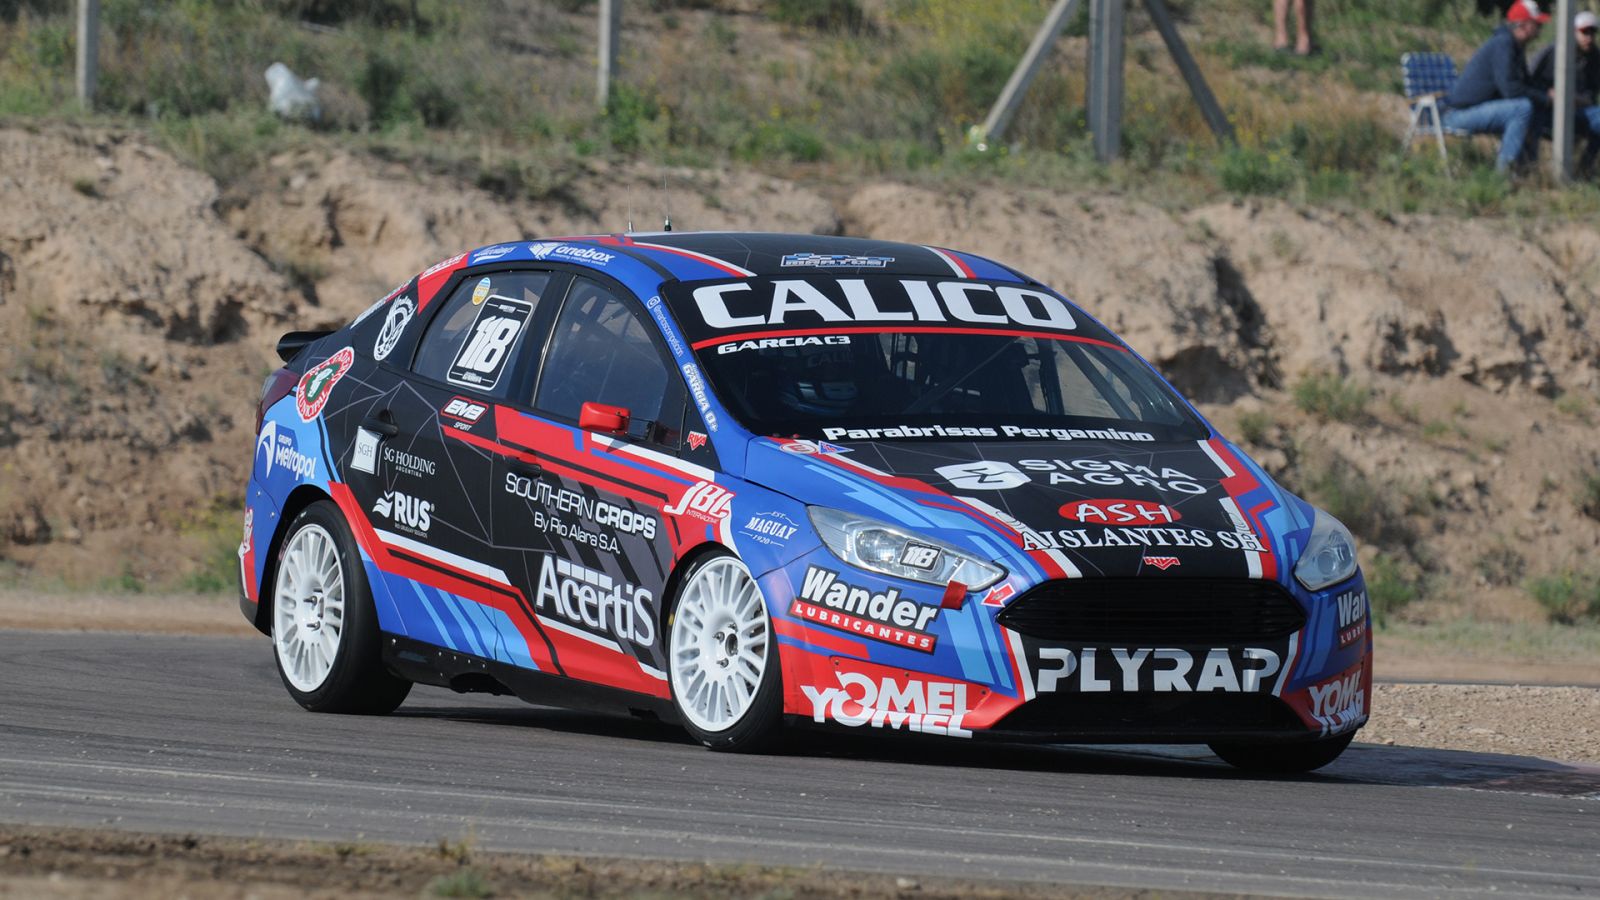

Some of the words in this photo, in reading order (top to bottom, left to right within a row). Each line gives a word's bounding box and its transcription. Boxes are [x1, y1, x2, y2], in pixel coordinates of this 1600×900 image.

[556, 245, 616, 263] onebox
[693, 279, 1077, 329] CALICO
[456, 316, 521, 373] 118
[717, 338, 824, 355] GARCIA
[825, 335, 851, 345] C3
[299, 384, 329, 417] MUNICIPAL
[453, 421, 473, 431] SPORT
[822, 425, 998, 441] Parabrisas
[1011, 426, 1155, 442] Pergamino
[275, 444, 316, 480] Metropol
[359, 443, 373, 458] SGH
[384, 447, 395, 462] SG
[396, 450, 436, 475] HOLDING
[1017, 459, 1198, 481] SIGMA
[1050, 472, 1208, 494] AGRO
[505, 472, 594, 519] SOUTHERN
[595, 501, 657, 539] CROPS
[663, 481, 735, 518] JBL
[1075, 502, 1174, 523] ASH
[534, 511, 549, 532] By
[550, 517, 568, 536] Rio
[568, 524, 598, 547] Alara
[599, 534, 620, 554] S.A.
[745, 517, 798, 540] MAGUAY
[752, 535, 770, 545] 1920
[1022, 527, 1213, 550] AISLANTES
[901, 546, 938, 567] 118
[536, 555, 656, 647] AcertiS
[801, 567, 937, 631] Wander
[795, 604, 930, 648] LUBRICANTES
[1037, 648, 1280, 692] PLYRAP
